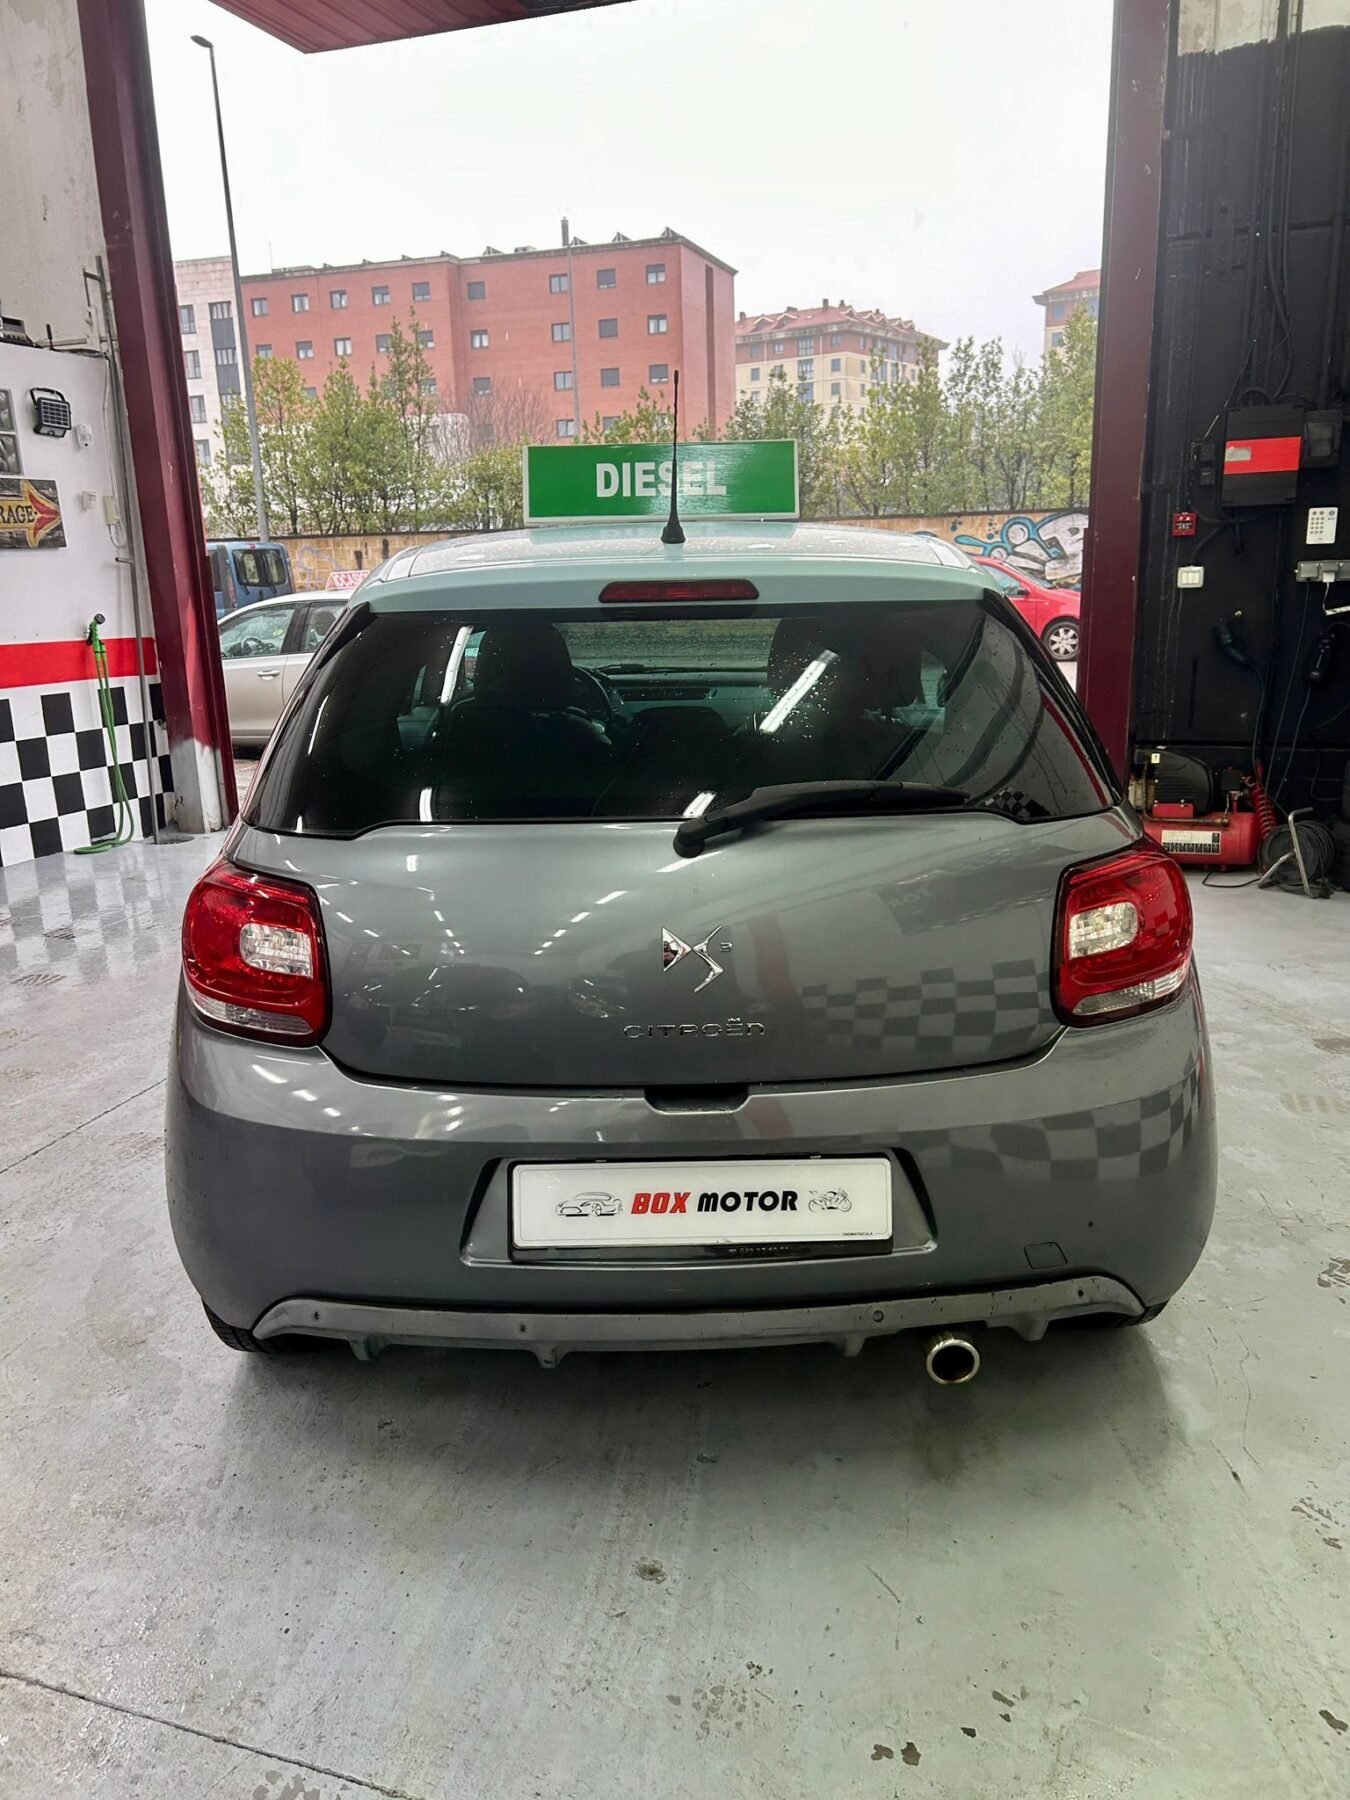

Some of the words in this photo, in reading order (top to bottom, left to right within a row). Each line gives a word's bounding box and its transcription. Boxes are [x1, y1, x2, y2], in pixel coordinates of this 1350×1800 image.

[596, 461, 727, 498] DIESEL
[631, 1191, 691, 1215] BOX
[697, 1190, 798, 1212] MOTOR
